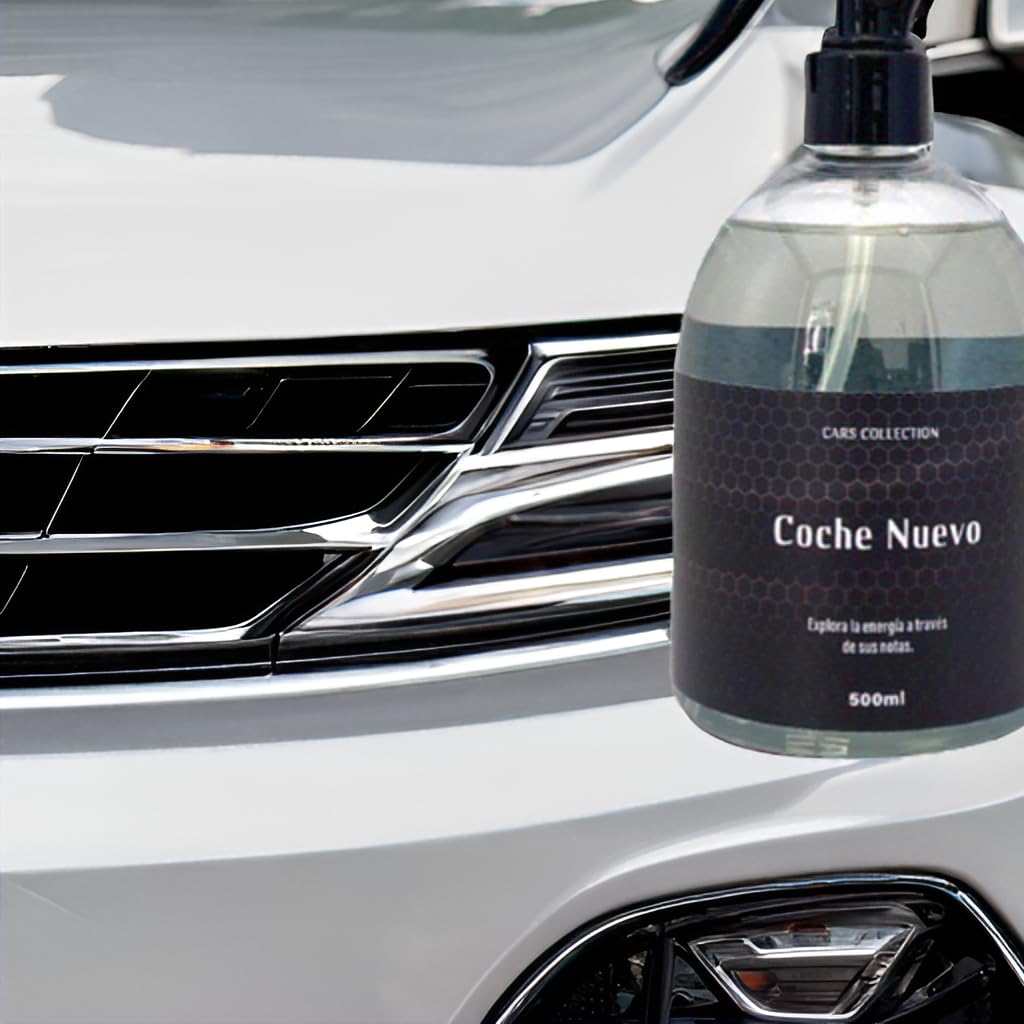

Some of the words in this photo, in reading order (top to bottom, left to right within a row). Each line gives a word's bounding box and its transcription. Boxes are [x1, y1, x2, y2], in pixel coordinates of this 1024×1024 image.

[822, 426, 857, 440] CARS
[860, 426, 940, 441] COLLECTION
[772, 514, 873, 551] Coche
[887, 518, 982, 550] Nuevo
[807, 616, 849, 635] Explora
[849, 619, 861, 634] la
[906, 620, 914, 633] a
[914, 616, 948, 633] través
[841, 640, 857, 655] de
[858, 641, 879, 655] sus
[879, 639, 914, 655] notas.
[848, 690, 906, 707] 500ml
